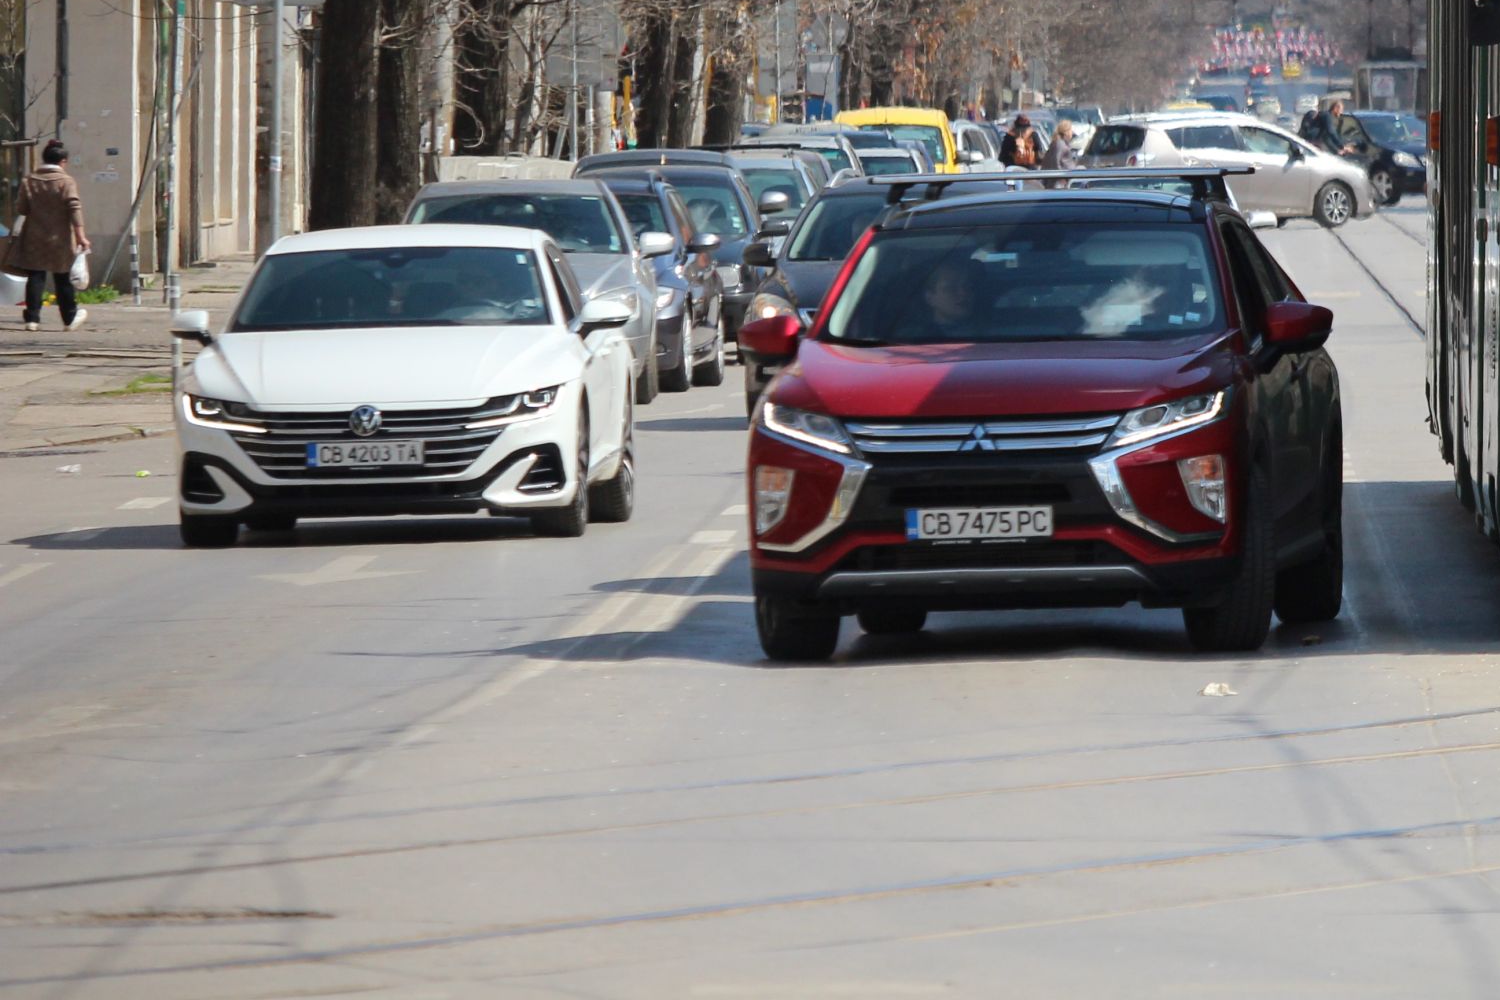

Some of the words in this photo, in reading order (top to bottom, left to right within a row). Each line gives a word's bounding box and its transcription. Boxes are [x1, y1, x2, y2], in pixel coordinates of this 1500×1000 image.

[319, 446, 343, 464] CB
[348, 445, 391, 463] 4203
[397, 444, 418, 462] TA
[922, 513, 951, 536] CB
[957, 511, 1012, 535] 7475
[1017, 510, 1047, 533] PC
